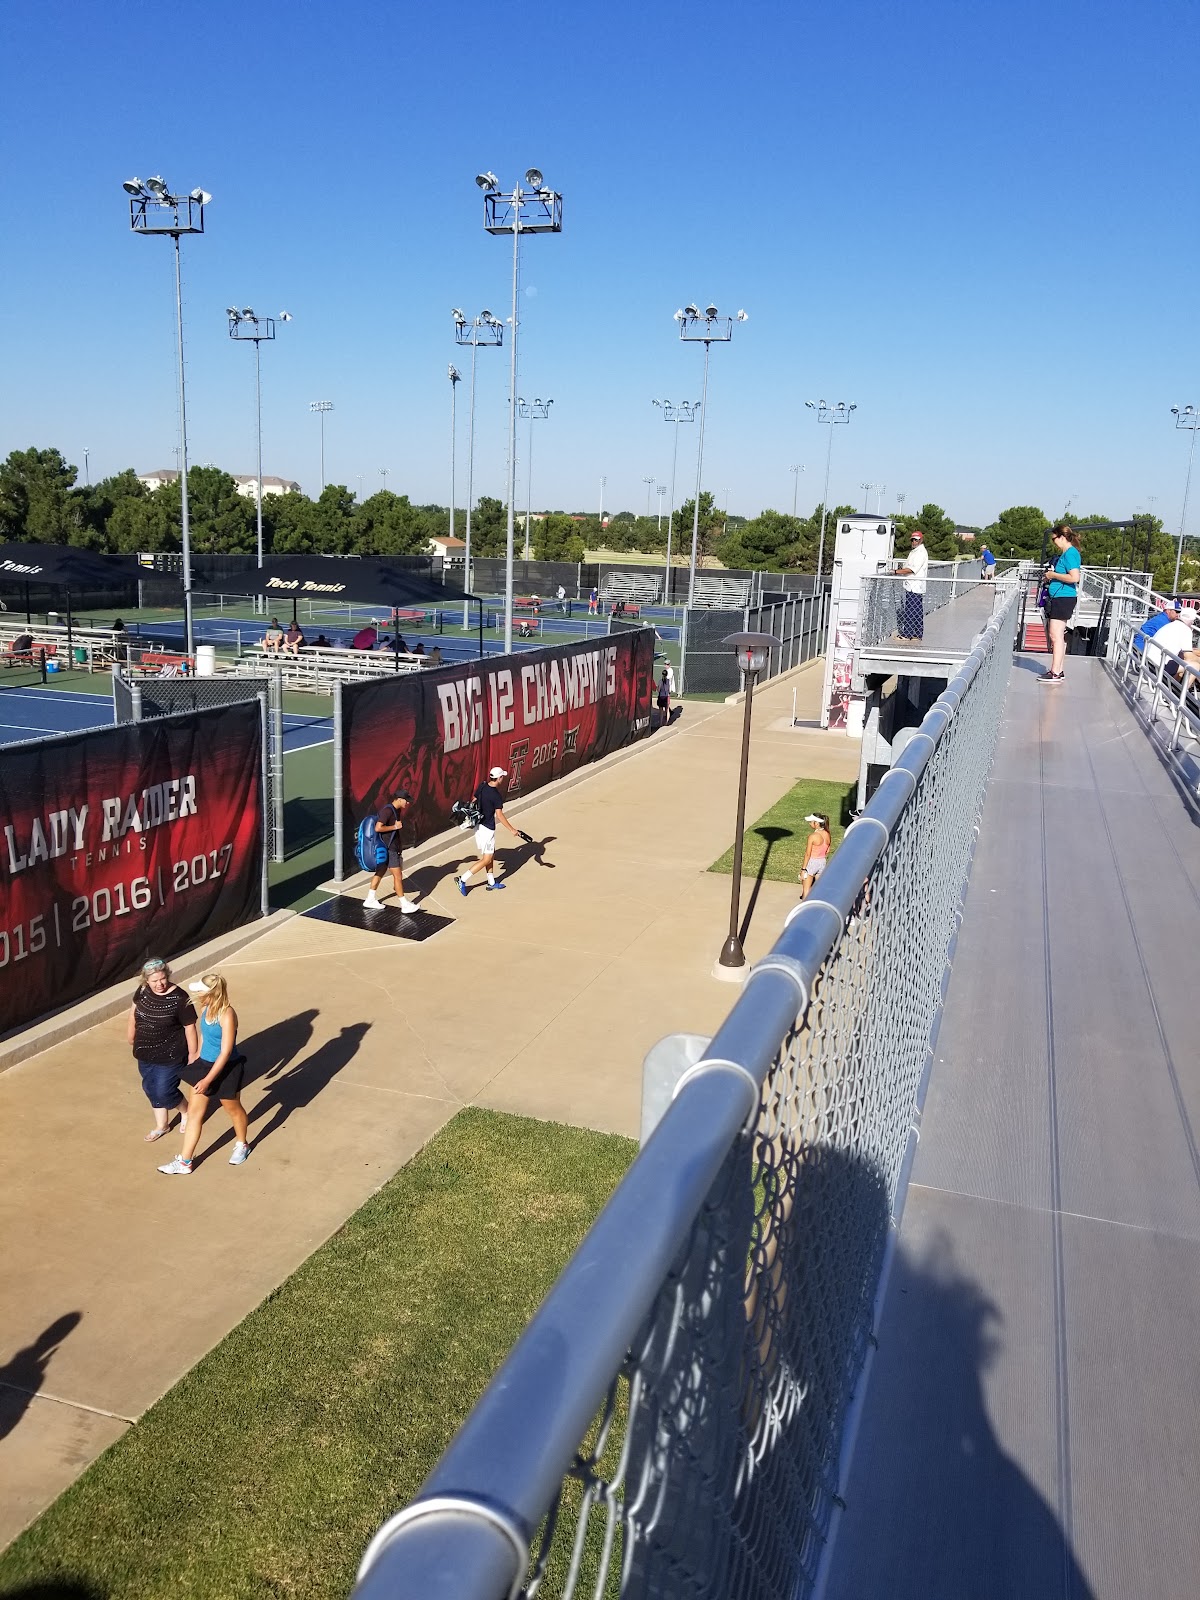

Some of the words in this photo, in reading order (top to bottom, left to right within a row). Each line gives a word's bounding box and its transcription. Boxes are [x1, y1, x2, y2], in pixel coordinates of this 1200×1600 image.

[0, 559, 43, 574] Tennis
[265, 577, 300, 590] Tech
[300, 580, 347, 593] Tennis
[436, 676, 485, 754] BIG
[488, 669, 515, 736] 12
[531, 738, 559, 769] 2016
[3, 804, 89, 874] LADY
[101, 775, 198, 842] RAIDER
[69, 836, 147, 870] TENNIS
[71, 876, 152, 933] 2016
[172, 843, 233, 893] 2017
